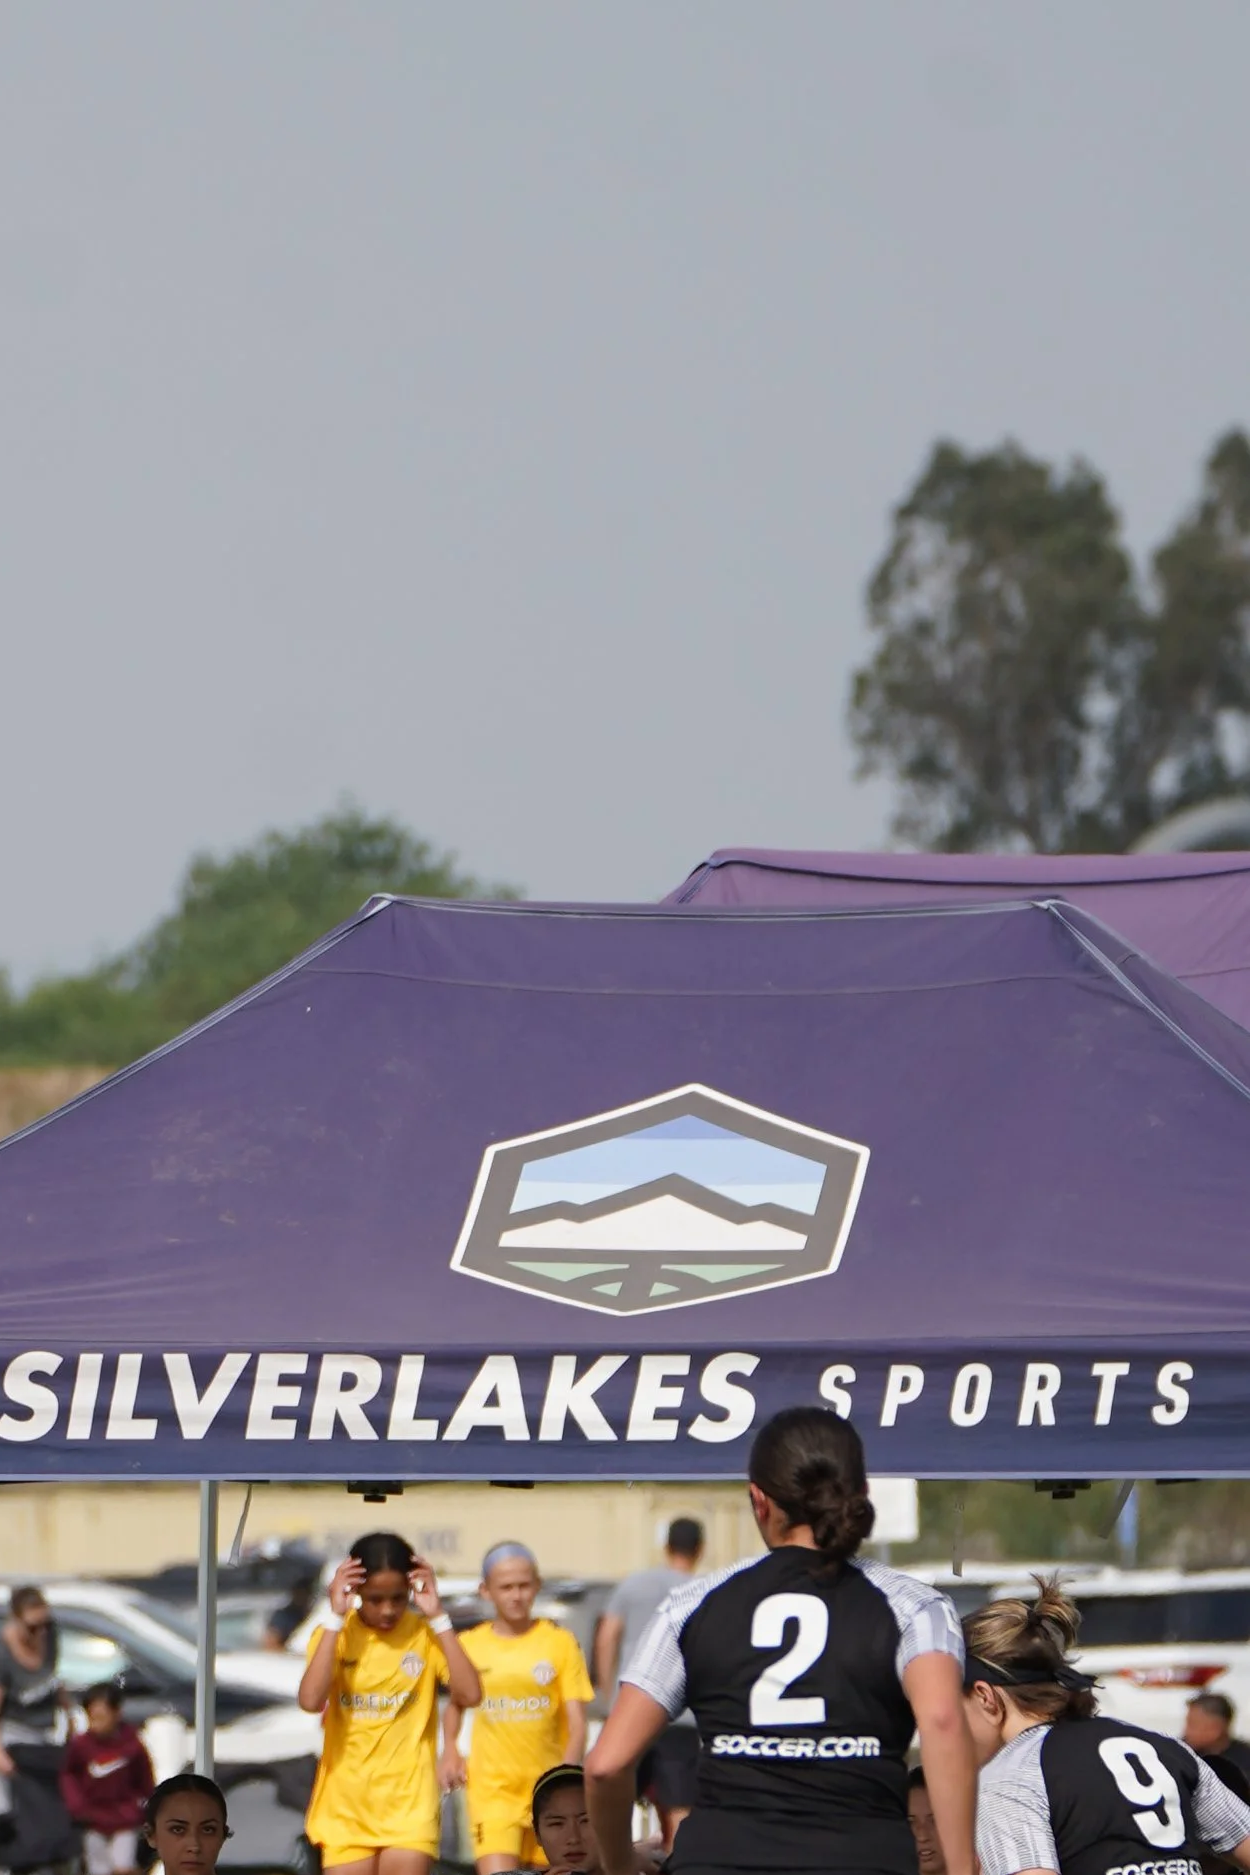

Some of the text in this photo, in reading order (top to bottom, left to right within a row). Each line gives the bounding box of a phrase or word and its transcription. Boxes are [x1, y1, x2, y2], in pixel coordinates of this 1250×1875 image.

[818, 1361, 1194, 1428] SPORTS
[750, 1592, 829, 1727] 2
[1098, 1736, 1186, 1849] 9
